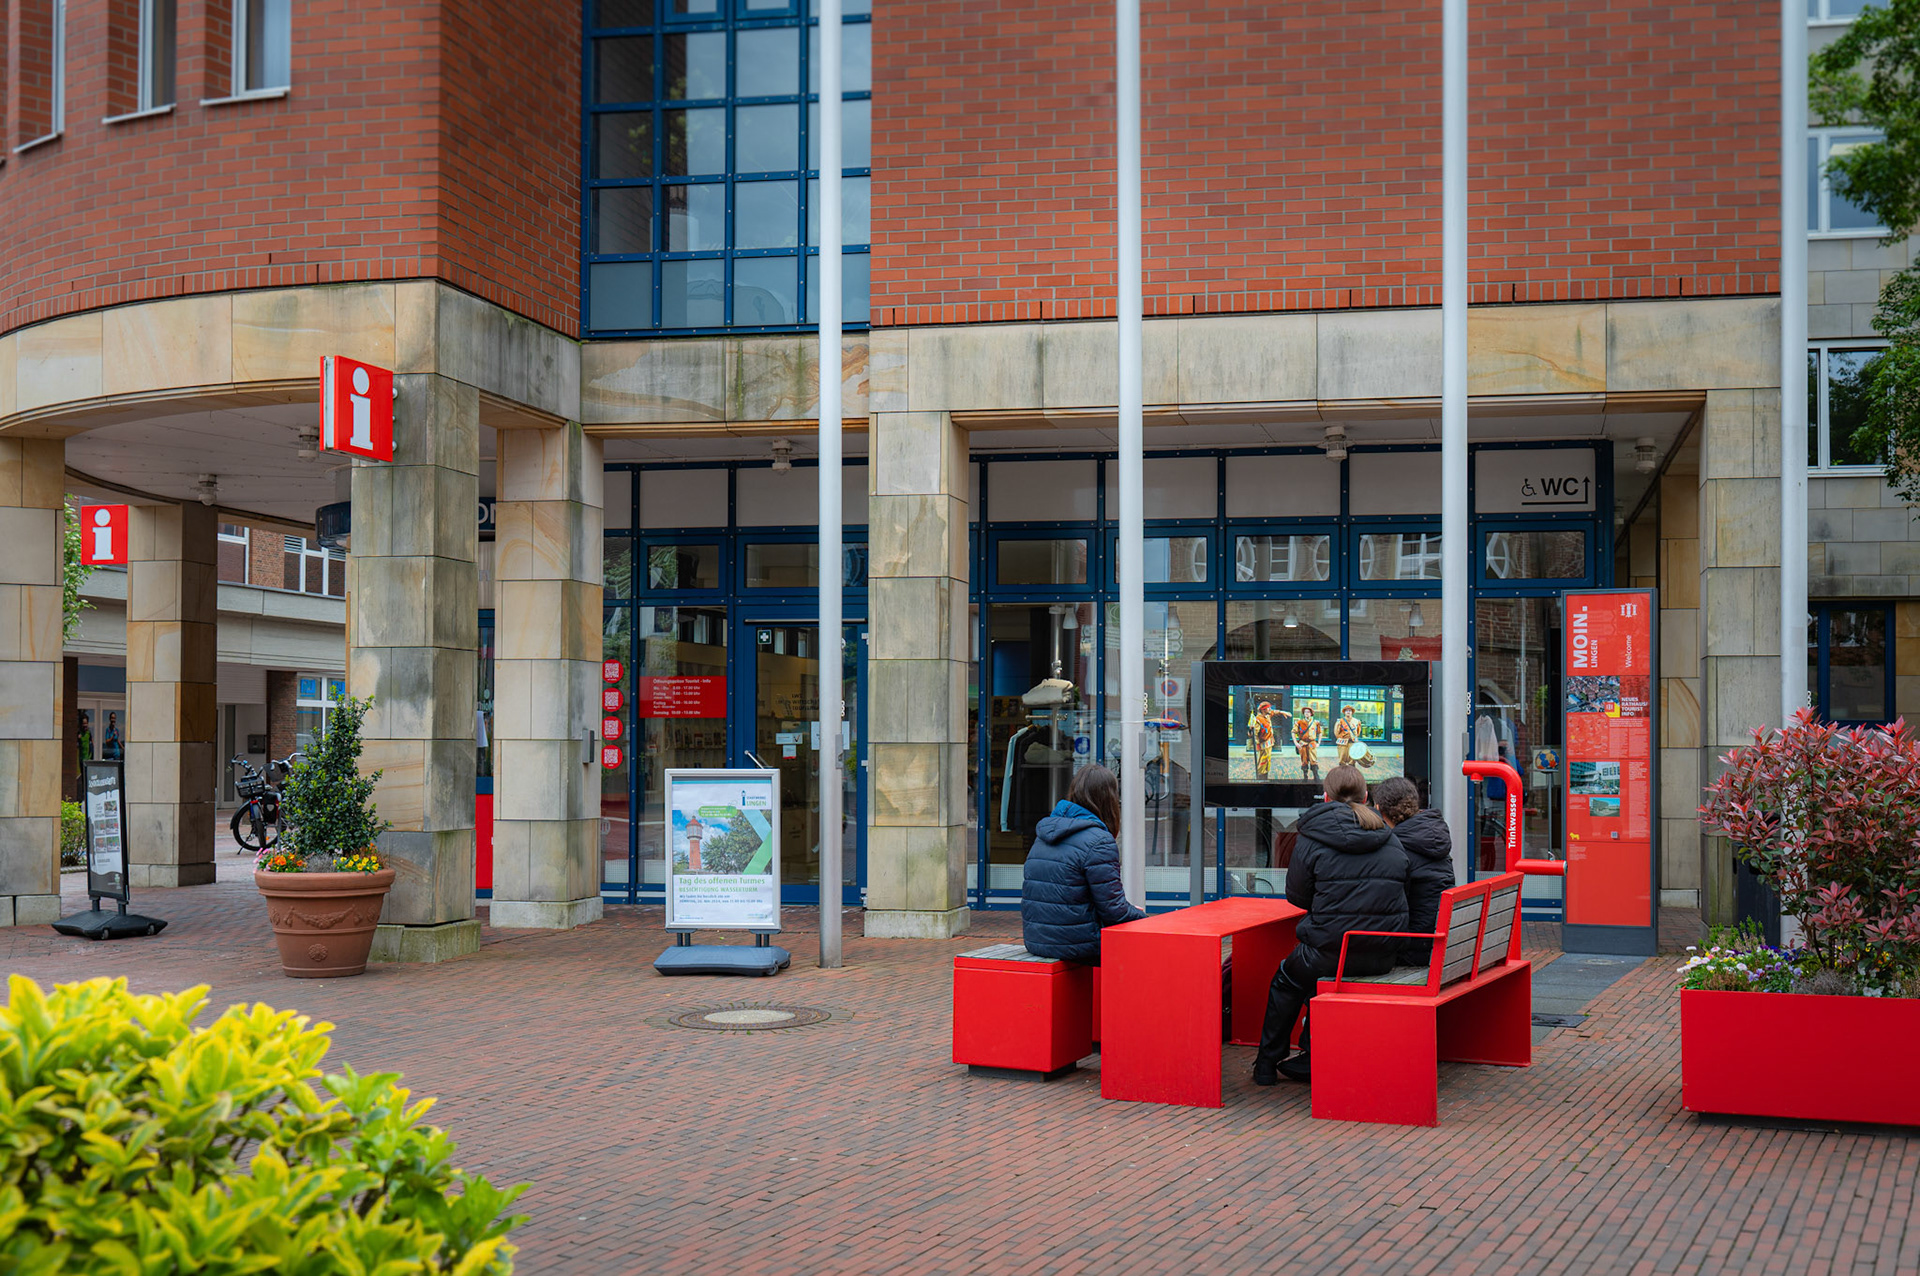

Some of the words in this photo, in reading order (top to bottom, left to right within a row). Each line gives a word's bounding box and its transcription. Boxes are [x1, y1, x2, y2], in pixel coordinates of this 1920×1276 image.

[1541, 477, 1579, 496] WC
[1573, 606, 1588, 668] MOIN.
[1590, 639, 1598, 668] LINGEN
[1508, 794, 1517, 848] Trinkwasser
[679, 877, 691, 885] Tag
